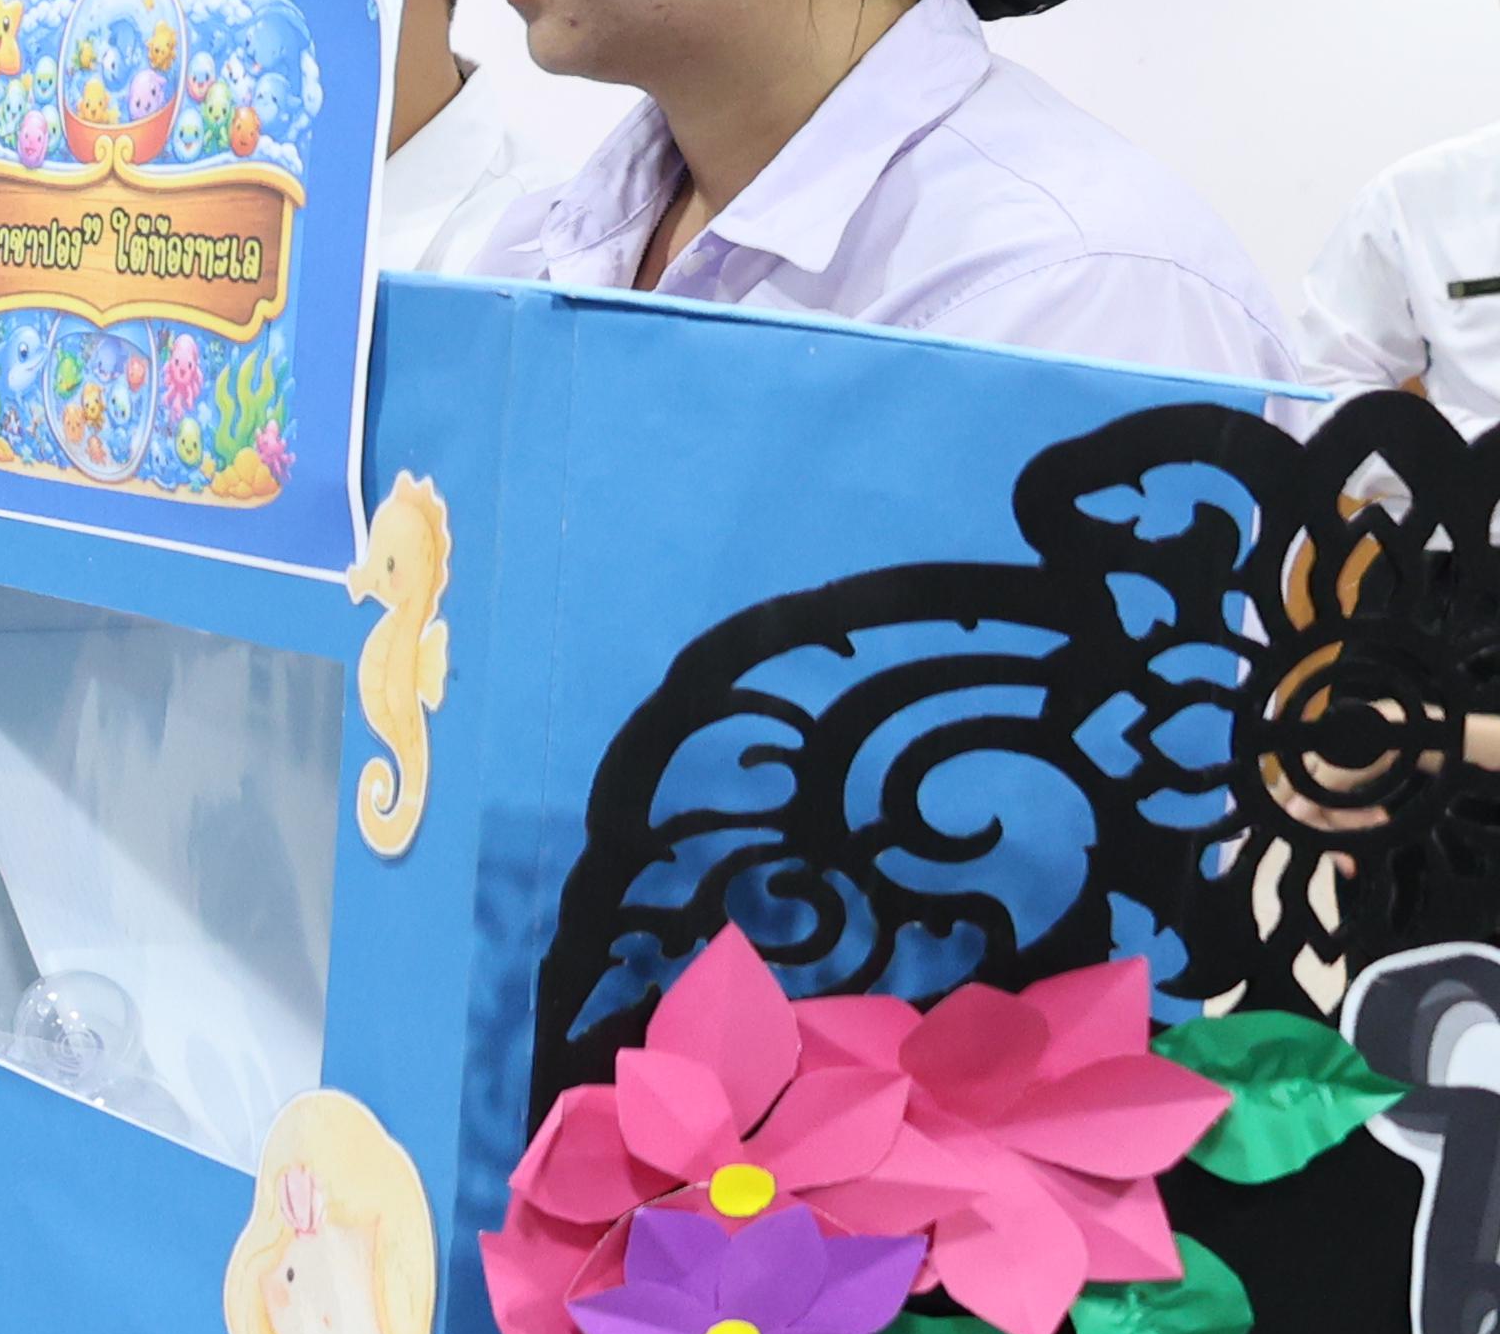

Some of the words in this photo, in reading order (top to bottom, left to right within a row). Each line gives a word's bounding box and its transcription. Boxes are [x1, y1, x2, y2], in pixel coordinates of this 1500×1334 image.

[109, 206, 263, 282] ใต้ท้องทะเล
